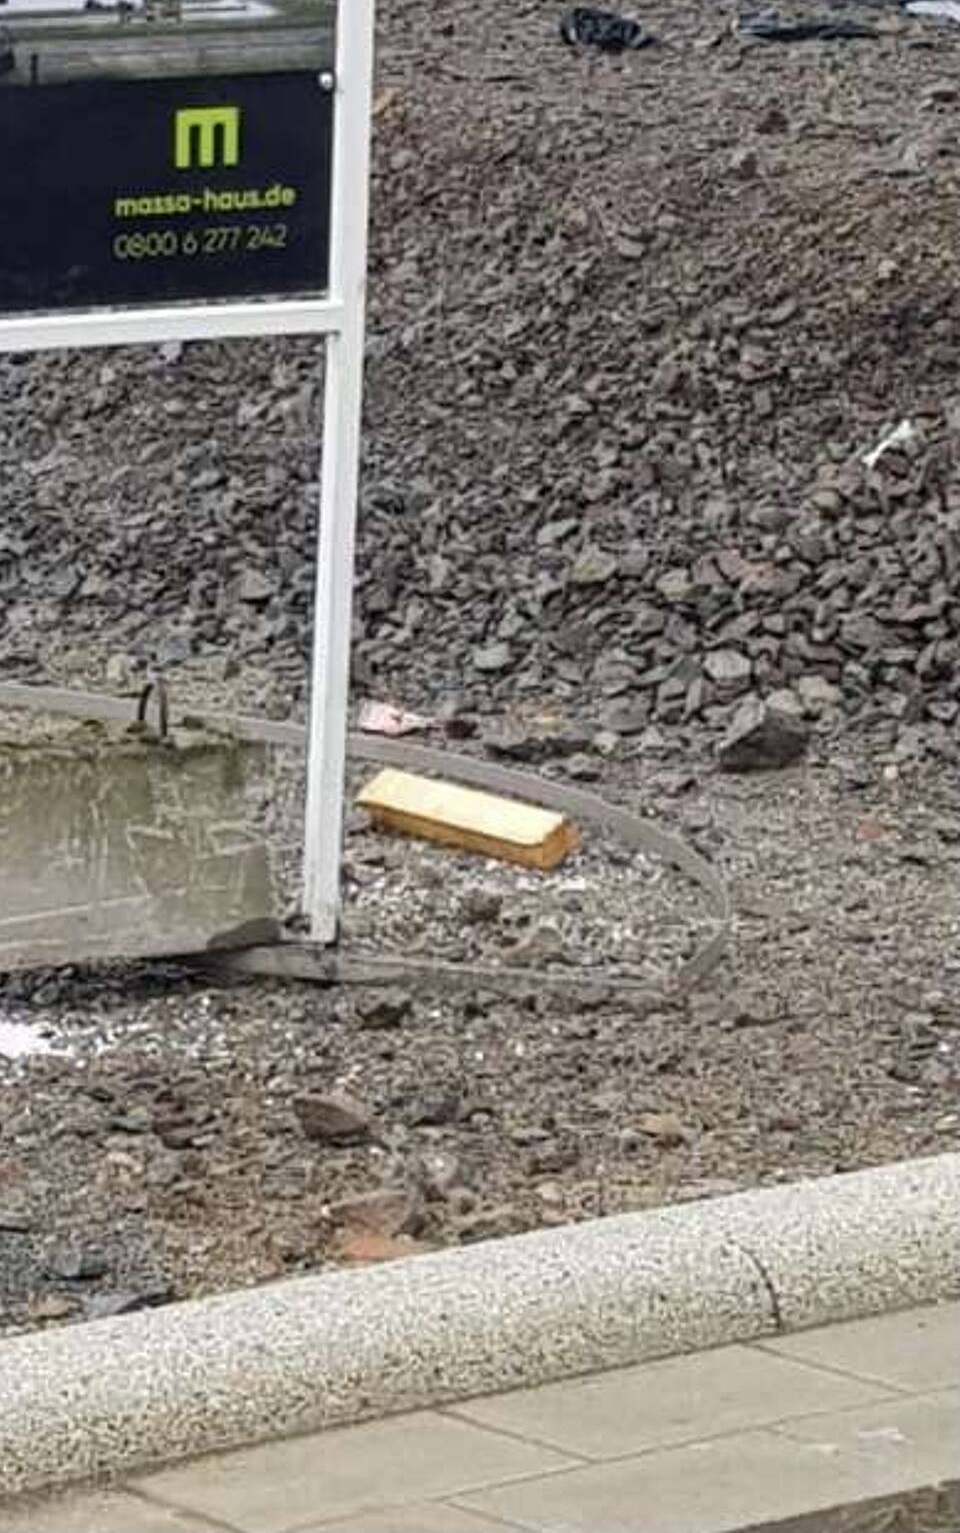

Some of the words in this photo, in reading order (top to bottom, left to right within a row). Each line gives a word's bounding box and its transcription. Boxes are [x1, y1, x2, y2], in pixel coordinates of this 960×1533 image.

[114, 183, 296, 216] massa-haus.de
[113, 231, 176, 259] 0800
[182, 231, 198, 255] 6
[201, 227, 239, 253] 277
[245, 224, 288, 250] 242
